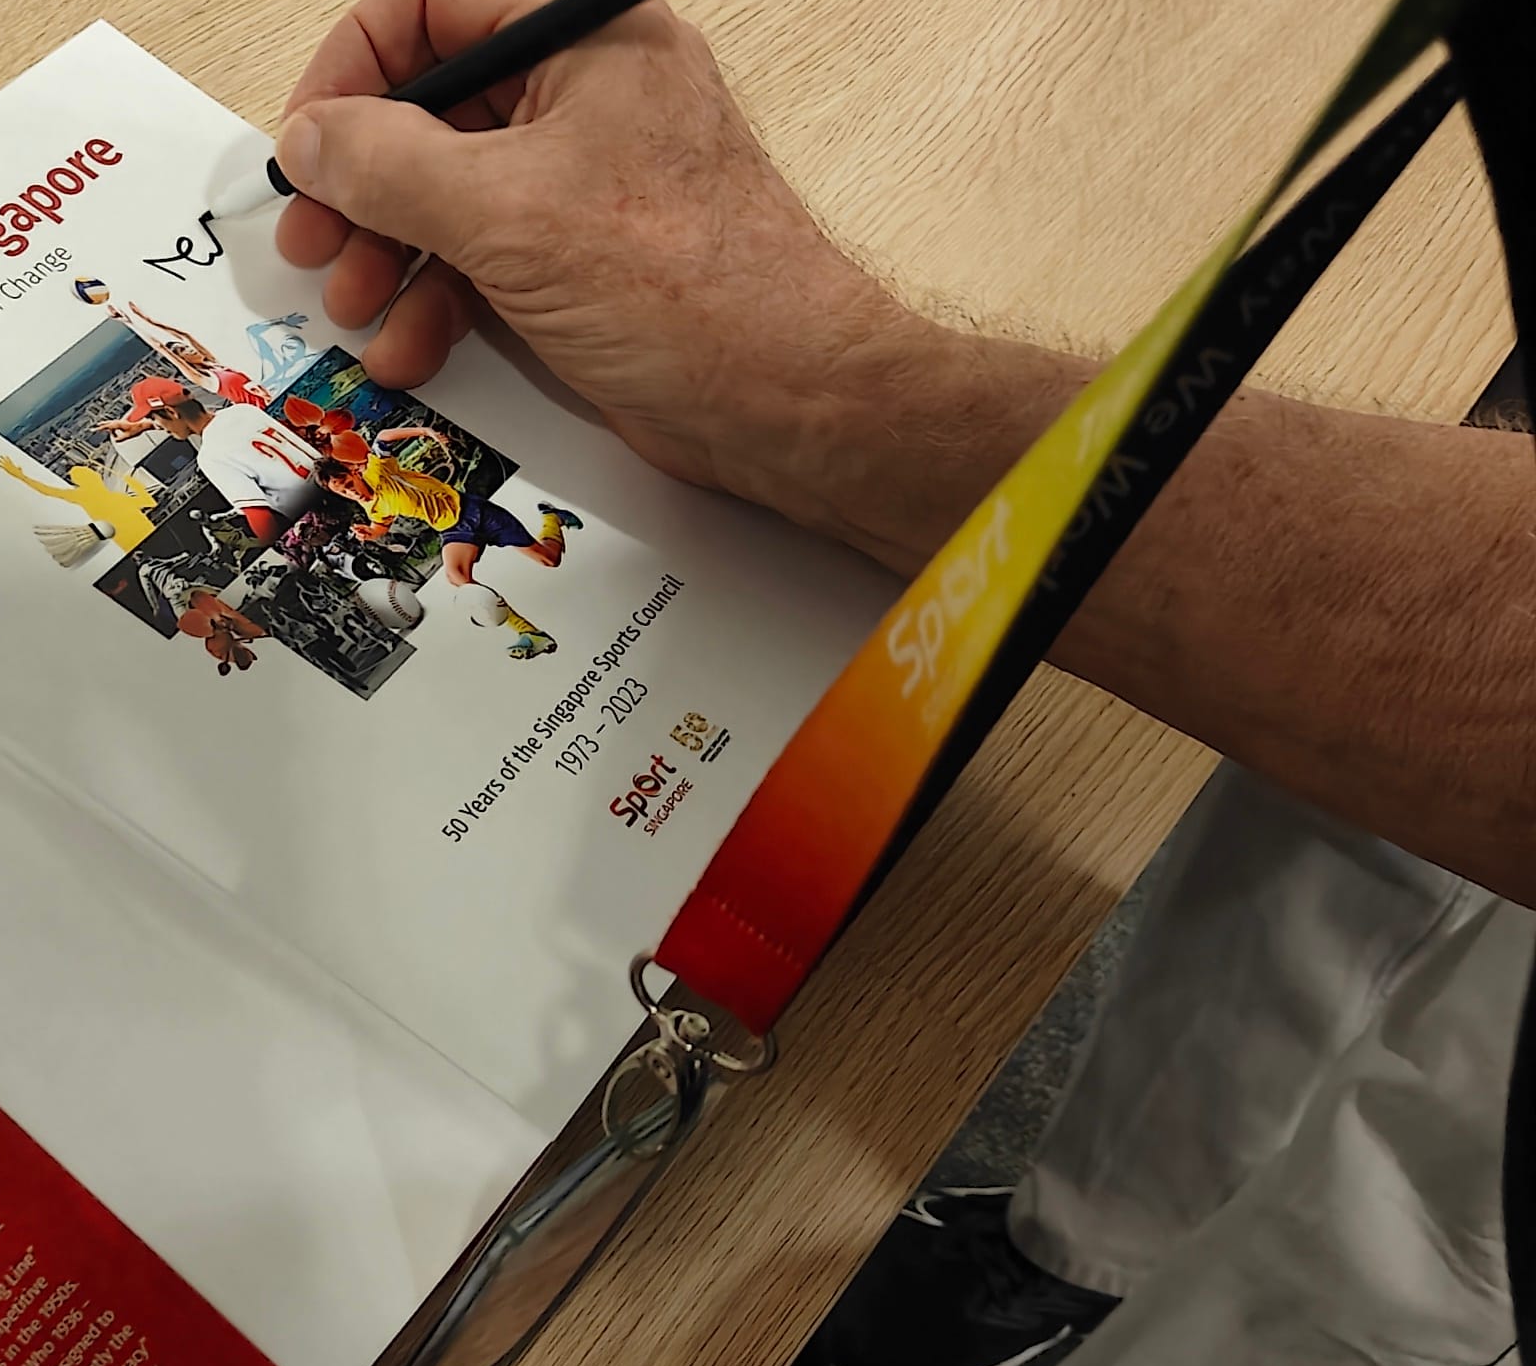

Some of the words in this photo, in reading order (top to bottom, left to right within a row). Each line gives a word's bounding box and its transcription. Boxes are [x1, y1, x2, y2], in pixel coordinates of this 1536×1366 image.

[0, 245, 73, 302] Change
[887, 495, 1013, 700] Sport
[441, 817, 470, 843] 50
[458, 778, 506, 820] Years
[500, 756, 521, 782] of
[513, 736, 543, 766] the
[533, 667, 603, 740] Singapore
[592, 625, 642, 672] Sports
[631, 573, 685, 627] Council
[555, 733, 600, 776] 1973
[601, 677, 648, 725] 2023
[609, 754, 677, 828] Sport
[643, 777, 694, 837] SINGAPORE
[3, 1343, 22, 1362] in
[15, 1318, 43, 1346] the
